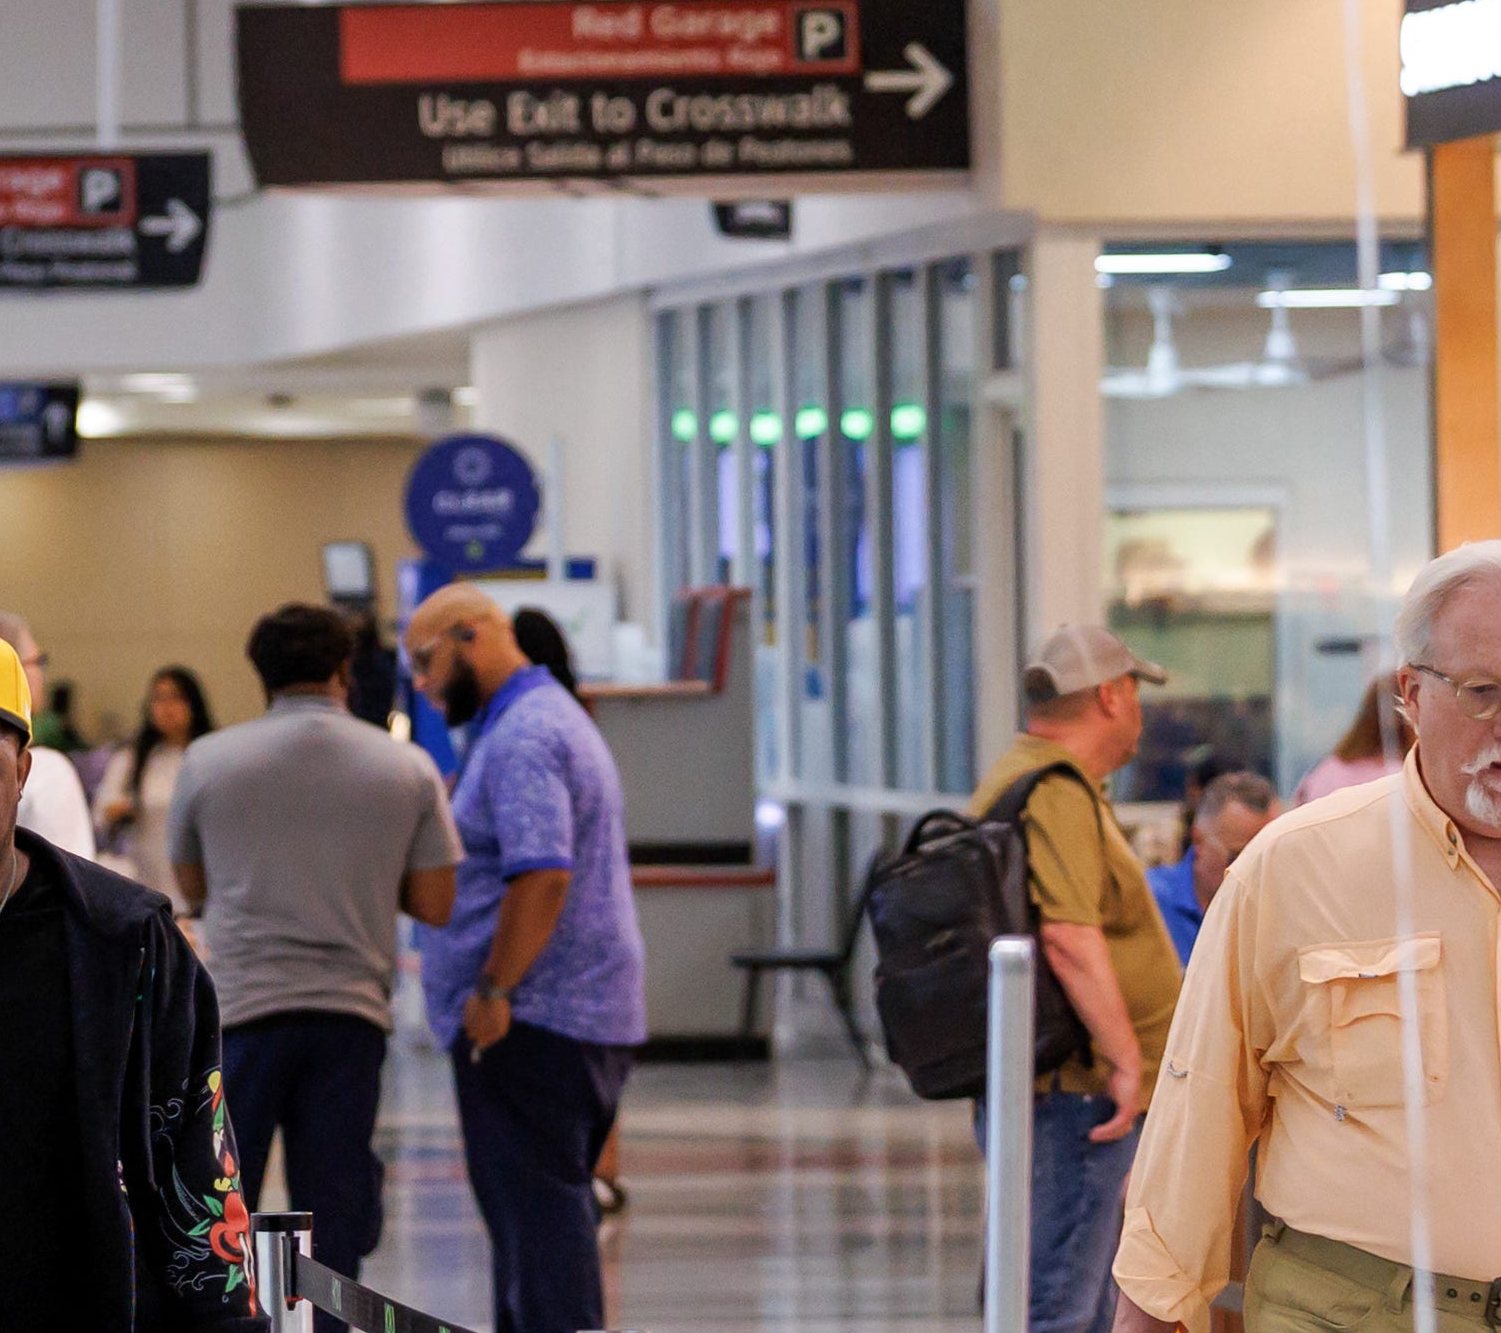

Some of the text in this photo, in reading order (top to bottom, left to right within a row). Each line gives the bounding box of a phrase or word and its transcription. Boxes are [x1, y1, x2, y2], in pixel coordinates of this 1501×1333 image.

[571, 5, 644, 42] Red
[650, 5, 782, 44] Garage
[417, 86, 850, 138] Use Exit to Crosswalk
